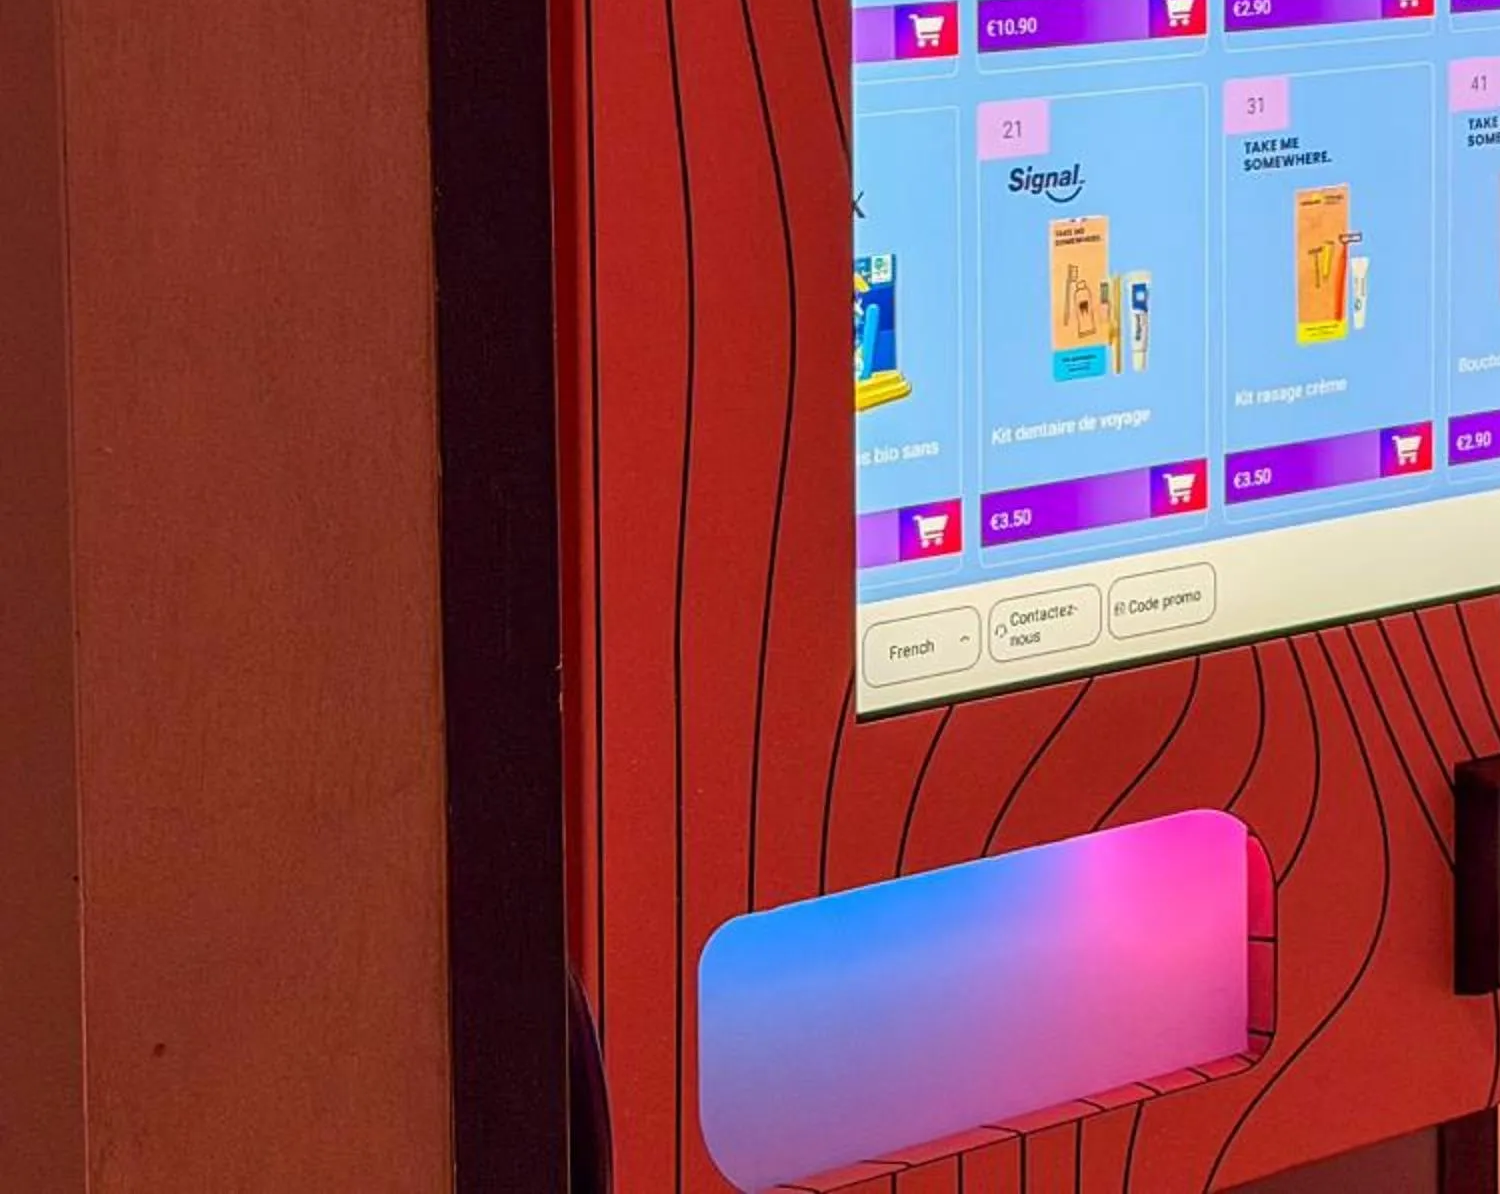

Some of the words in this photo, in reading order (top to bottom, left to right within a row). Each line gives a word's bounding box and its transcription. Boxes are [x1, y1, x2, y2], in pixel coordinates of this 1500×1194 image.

[986, 17, 1038, 37] €10.90
[1471, 75, 1487, 91] 41
[1247, 97, 1264, 115] 31
[1002, 120, 1022, 139] 21
[1468, 115, 1499, 130] TAKE
[1244, 138, 1278, 154] TAKE
[1280, 137, 1300, 151] ME
[1244, 150, 1332, 172] SOMEWHERE.
[1008, 163, 1081, 194] Signal
[1235, 388, 1253, 406] Kit
[991, 426, 1012, 445] Kit
[1015, 419, 1077, 442] dentaire
[1078, 415, 1096, 432] de
[1101, 409, 1151, 431] voyage
[902, 440, 939, 459] sans
[1456, 430, 1492, 451] €2.90
[1233, 467, 1272, 489] €3.50
[990, 508, 1033, 531] €3.50
[1128, 596, 1159, 616] Code
[1162, 590, 1202, 612] promo
[1009, 603, 1078, 628] Contactez-
[1009, 630, 1041, 648] nous
[888, 639, 935, 662] French
